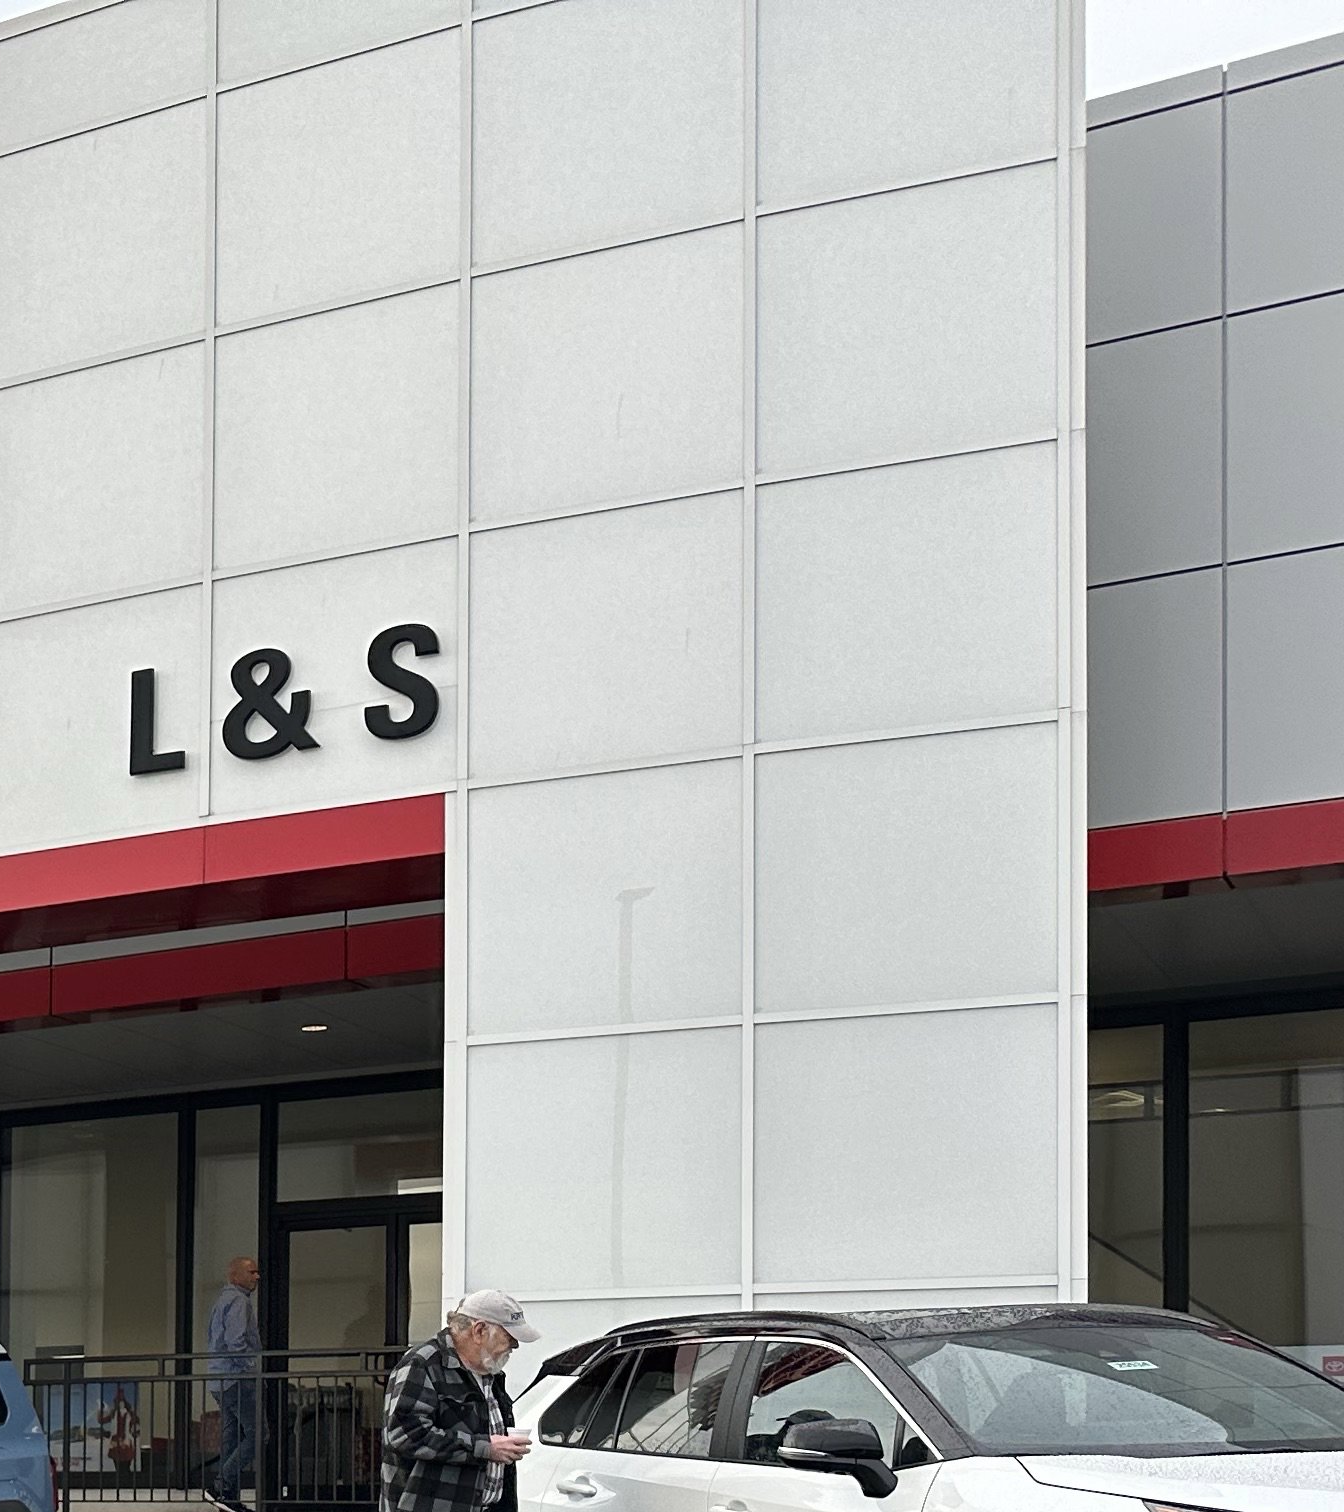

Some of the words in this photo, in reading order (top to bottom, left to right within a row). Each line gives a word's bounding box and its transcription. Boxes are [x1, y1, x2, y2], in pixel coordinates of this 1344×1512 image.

[129, 667, 186, 776] L
[222, 648, 321, 760] &
[364, 623, 440, 740] S
